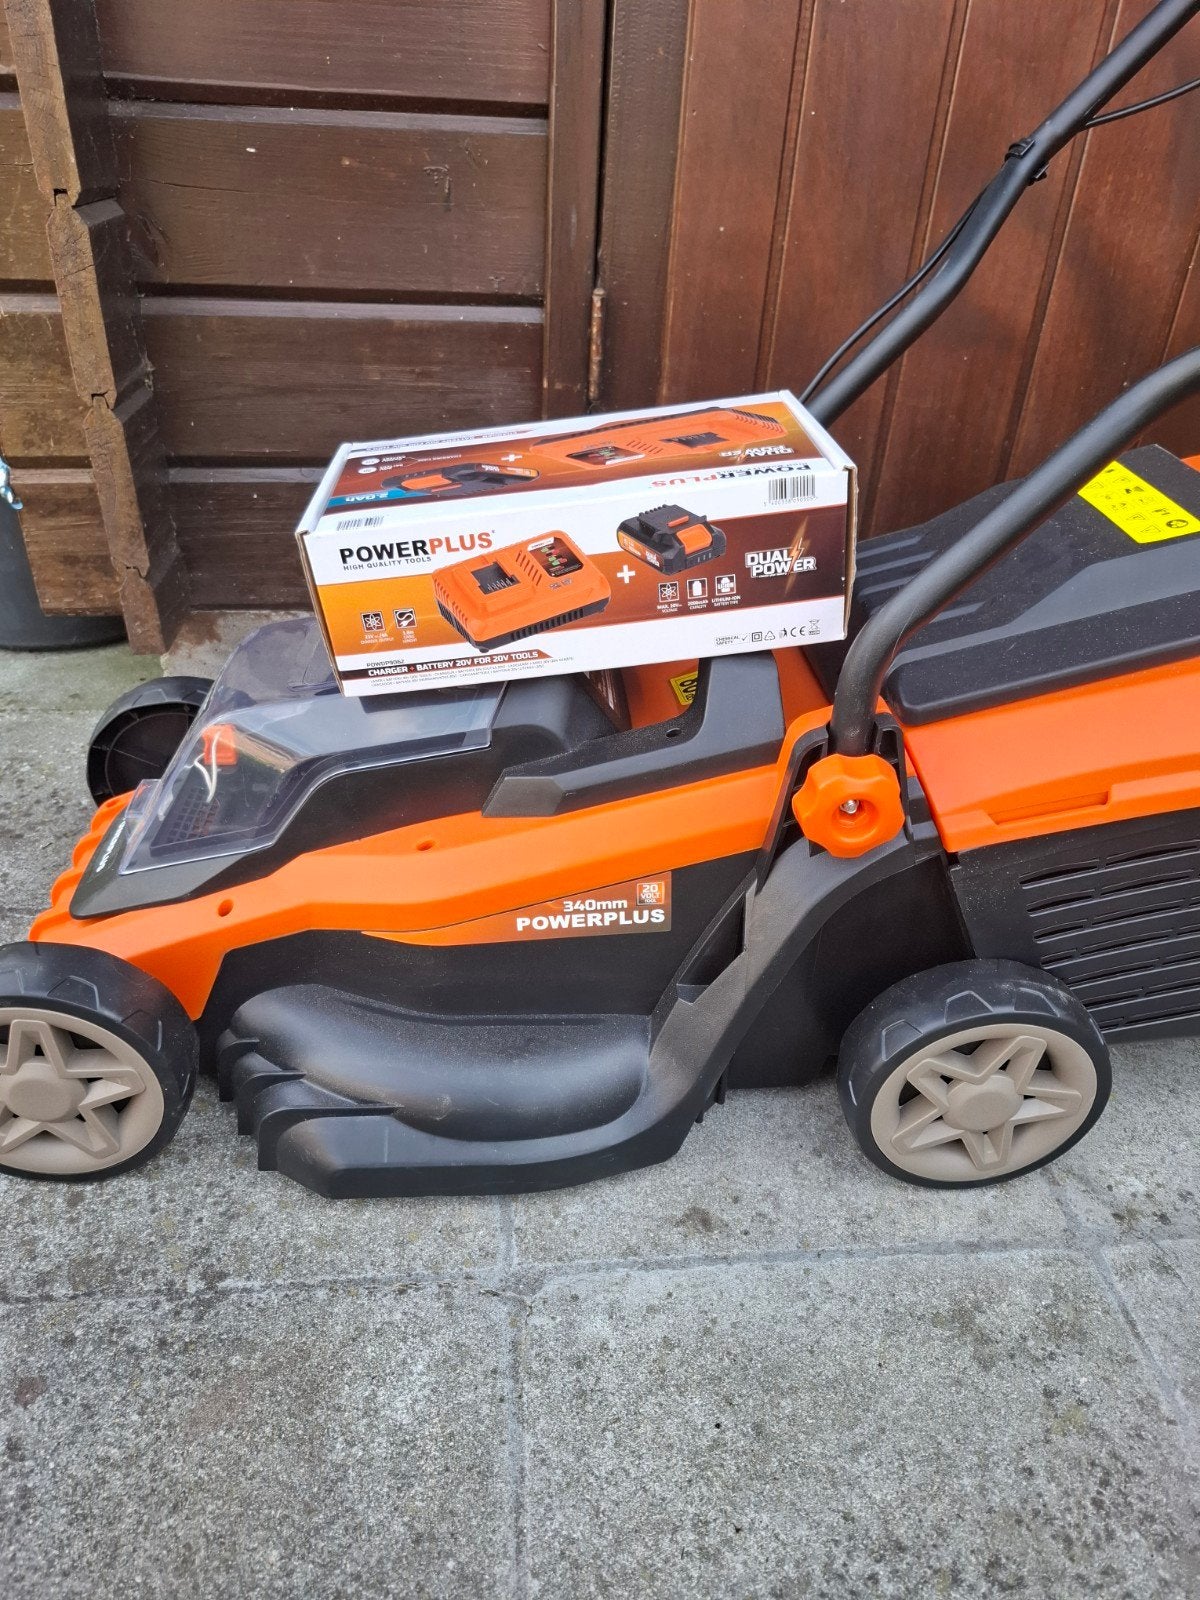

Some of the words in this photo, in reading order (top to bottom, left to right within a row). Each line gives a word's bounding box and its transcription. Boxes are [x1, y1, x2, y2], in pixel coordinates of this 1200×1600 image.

[651, 464, 811, 487] POWERPLUS
[339, 532, 493, 564] POWERPLUS
[343, 562, 364, 571] HIGH
[367, 559, 402, 569] QUALITY
[406, 556, 432, 564] TOOLS
[747, 549, 793, 566] DUAL
[752, 558, 815, 577] POWER
[367, 666, 408, 677] CHARGER
[416, 661, 454, 671] BATTERY
[456, 658, 472, 667] 20V
[474, 656, 491, 665] FOR
[493, 654, 509, 663] 20V
[511, 651, 539, 660] TOOLS
[640, 892, 660, 900] VOLT
[642, 884, 658, 894] 20
[563, 899, 627, 912] 340mm
[516, 909, 665, 932] POWERPLUS
